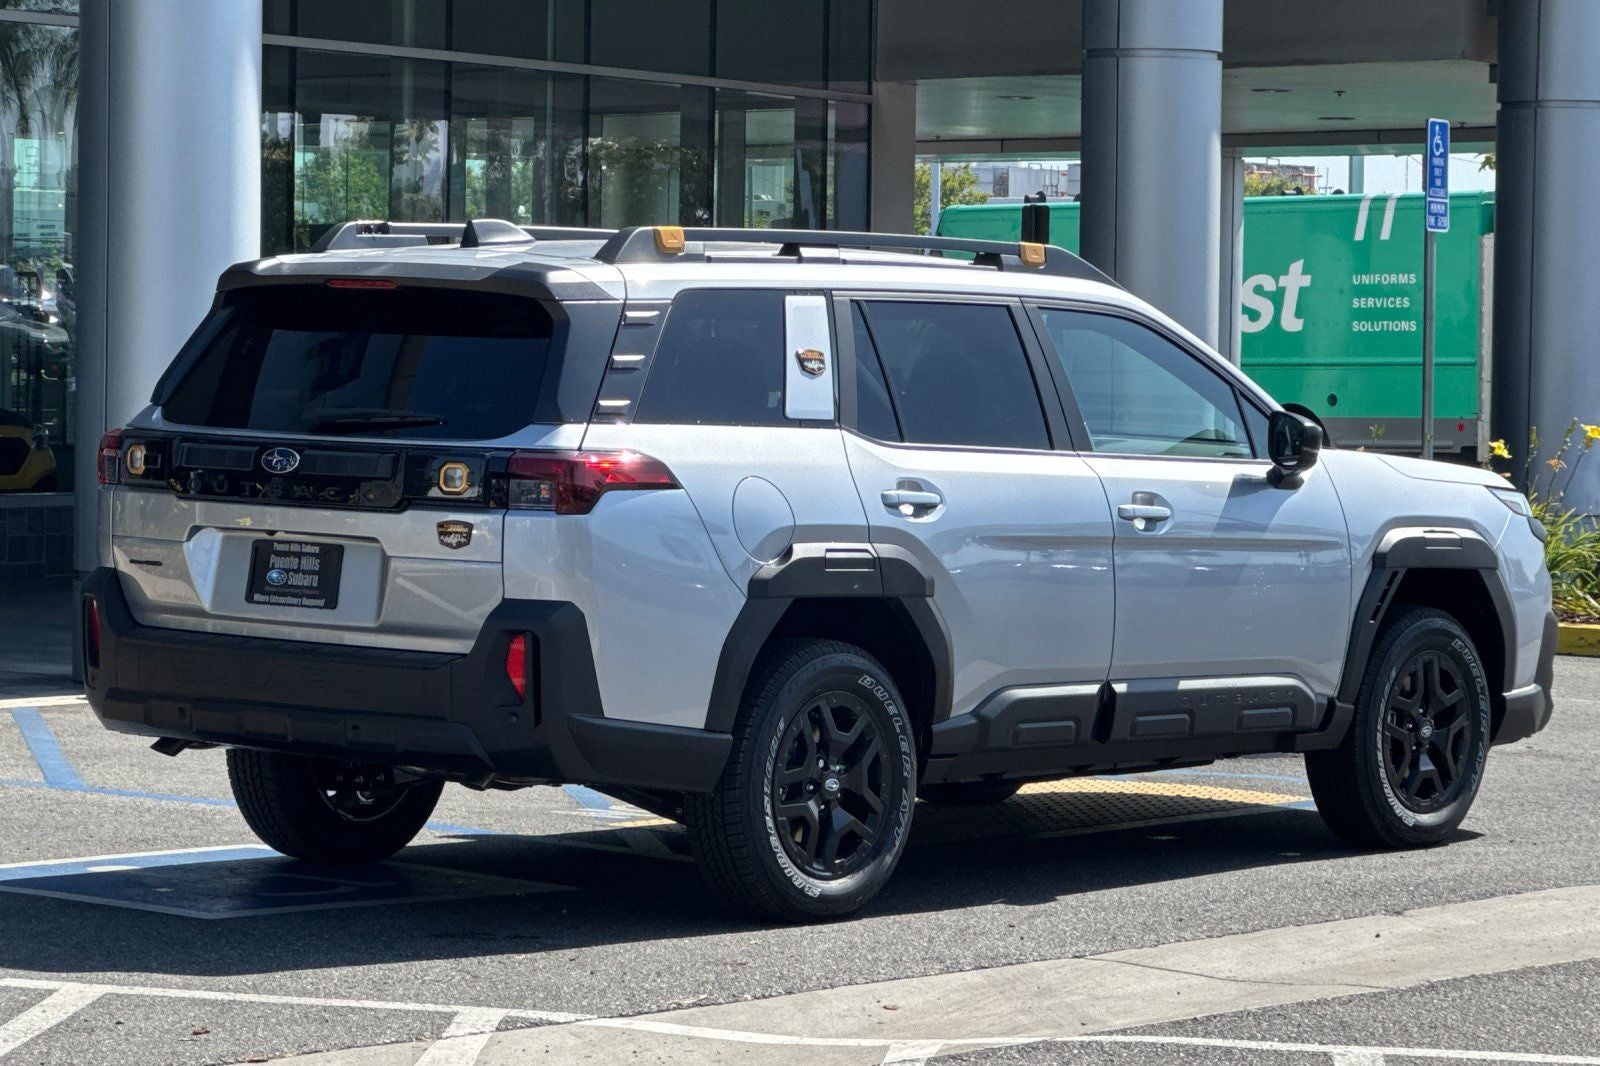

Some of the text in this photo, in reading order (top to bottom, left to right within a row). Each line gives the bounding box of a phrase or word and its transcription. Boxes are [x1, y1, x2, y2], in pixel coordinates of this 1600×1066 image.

[1352, 273, 1417, 285] UNIFORMS
[1241, 259, 1311, 333] st
[1352, 297, 1411, 309] SERVICES
[1352, 320, 1417, 332] SOLUTIONS
[187, 475, 375, 503] OUTBACK
[302, 543, 320, 553] Subaru
[269, 554, 320, 570] Puente Hills
[288, 571, 318, 586] Subaru
[1181, 690, 1296, 708] OUTBACK
[763, 717, 822, 898] BRIDGESTONE
